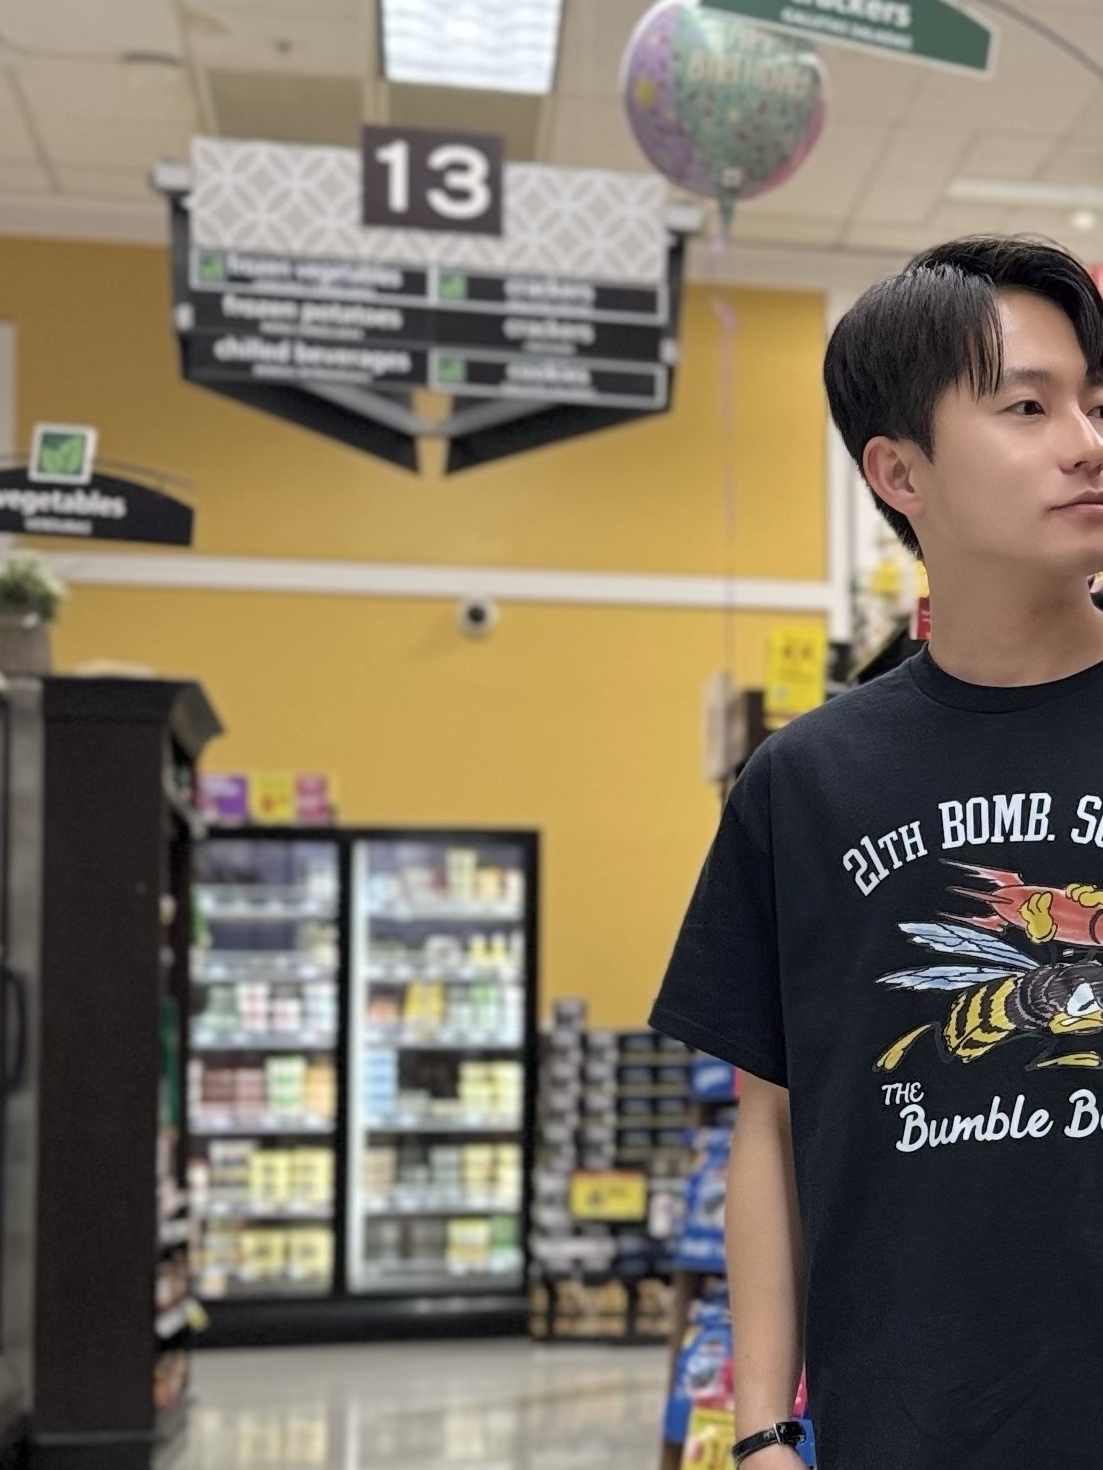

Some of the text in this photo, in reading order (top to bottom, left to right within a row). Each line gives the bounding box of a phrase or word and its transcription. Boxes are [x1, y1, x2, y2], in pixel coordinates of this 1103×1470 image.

[374, 140, 493, 219] 13
[842, 820, 928, 897] 21TH
[938, 792, 1056, 850] BOMB.
[881, 1082, 924, 1105] THE
[895, 1095, 1055, 1153] Bumble
